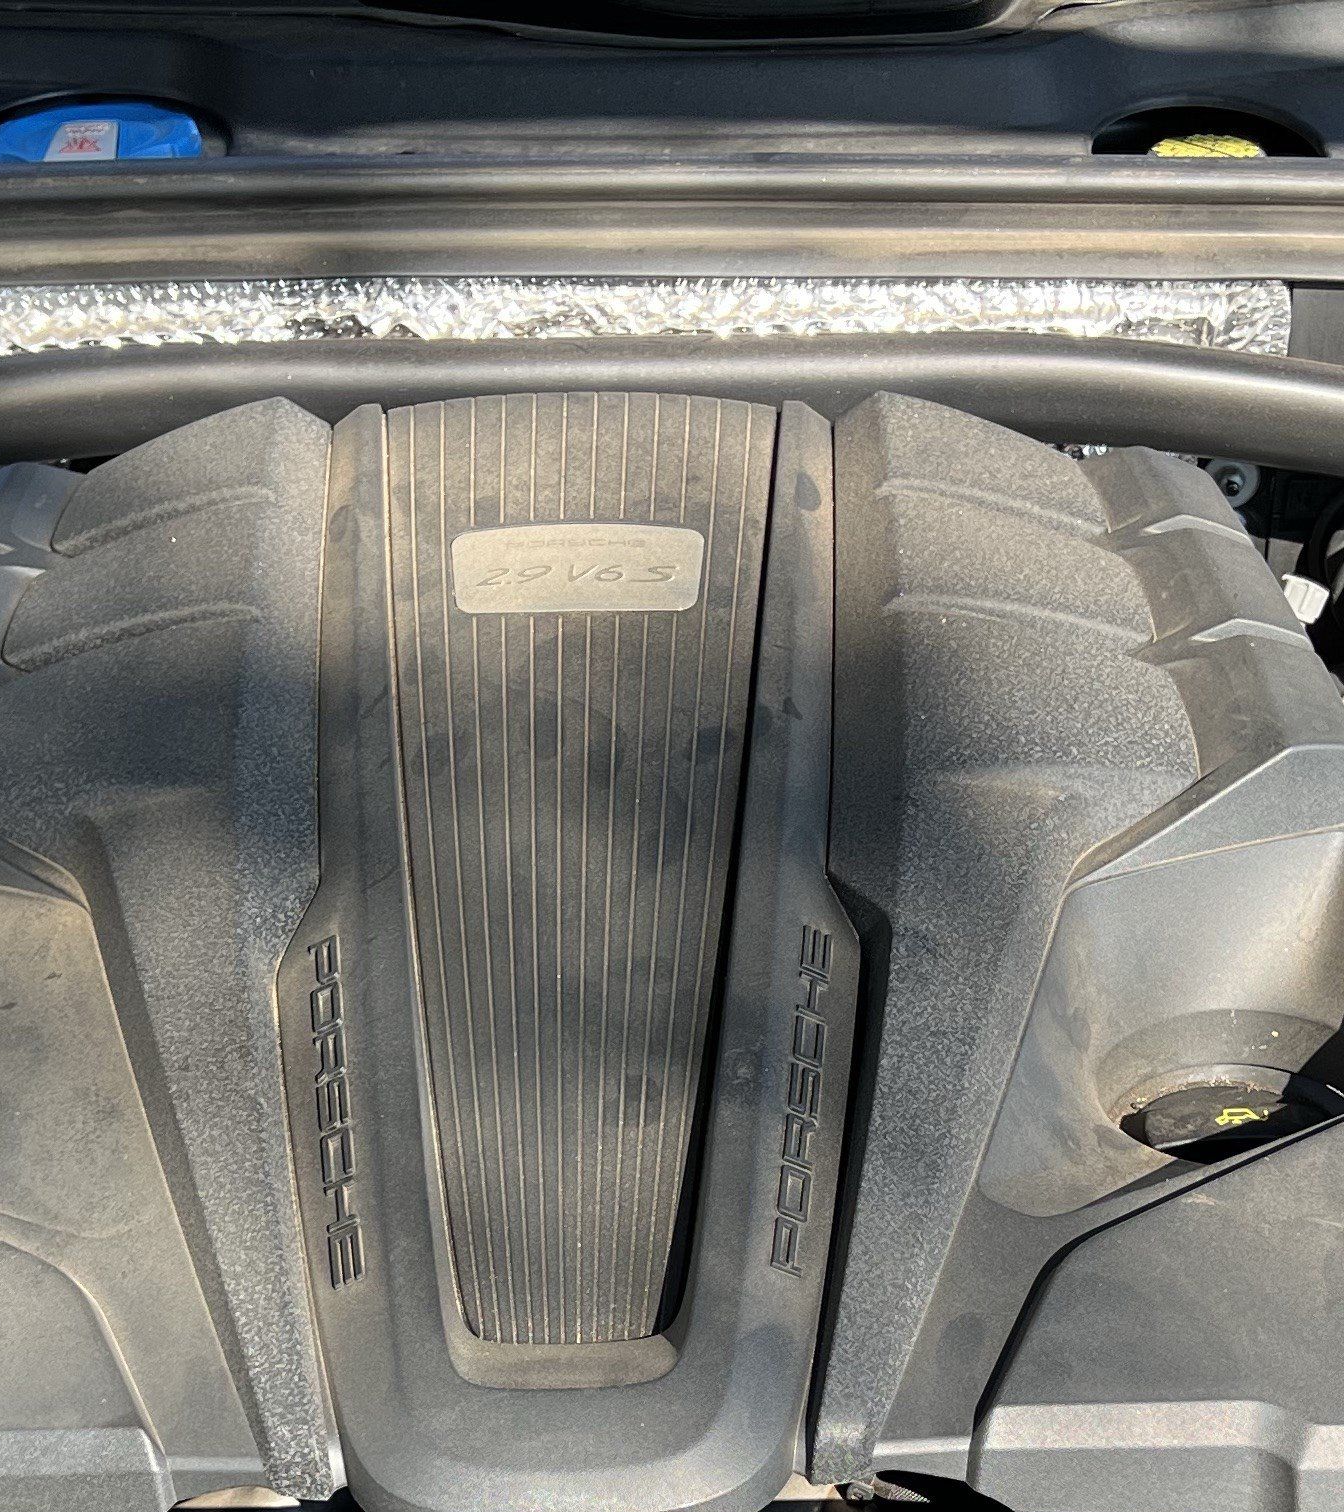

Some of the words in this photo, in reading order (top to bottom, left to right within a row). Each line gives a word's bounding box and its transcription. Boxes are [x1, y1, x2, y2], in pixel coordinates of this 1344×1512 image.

[567, 564, 623, 582] V6
[630, 566, 677, 582] S
[307, 934, 366, 1290] PORSCHE
[770, 924, 833, 1278] PORSCHE
